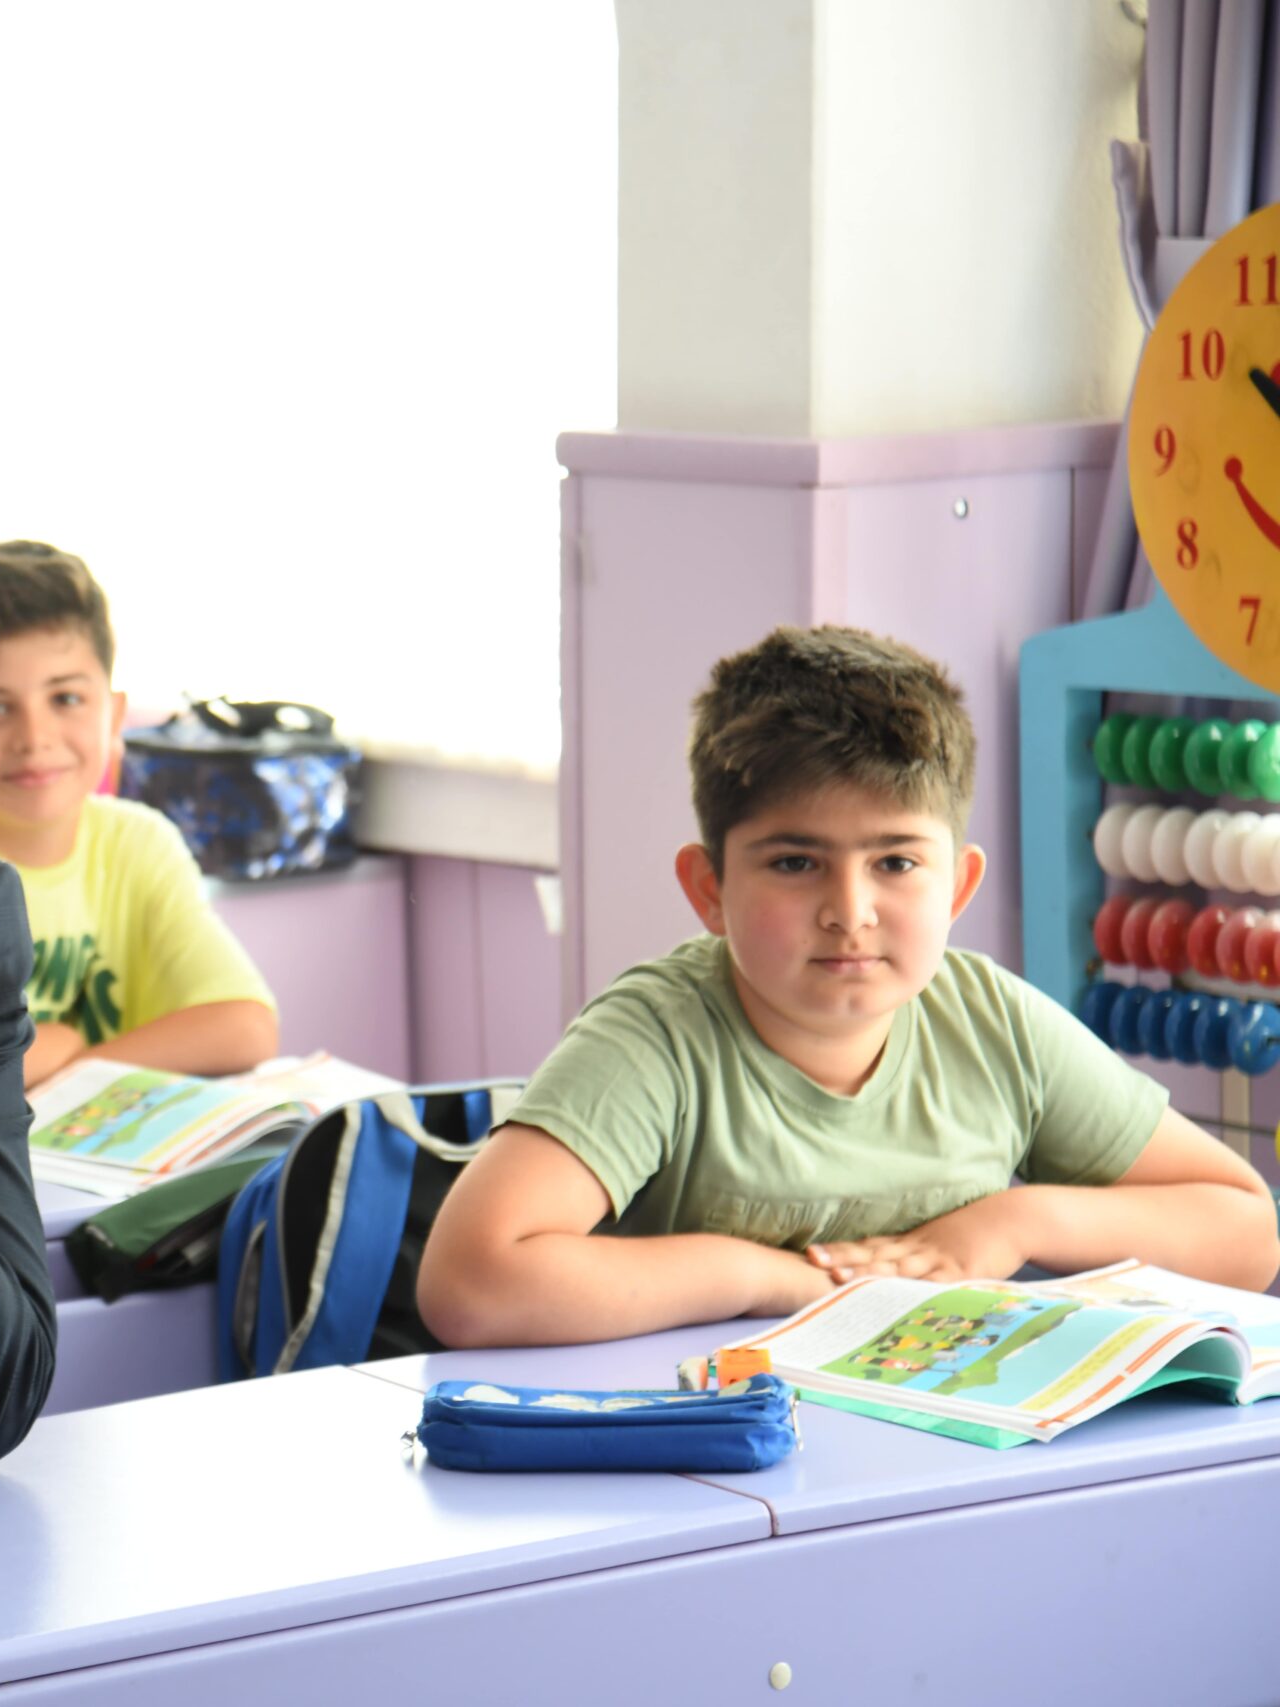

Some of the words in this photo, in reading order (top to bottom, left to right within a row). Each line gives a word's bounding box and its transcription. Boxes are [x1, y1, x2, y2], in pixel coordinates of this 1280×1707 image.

[1236, 255, 1280, 306] 11
[1178, 328, 1225, 380] 10
[1154, 424, 1176, 477] 9
[1177, 517, 1199, 570] 8
[1239, 595, 1262, 646] 7
